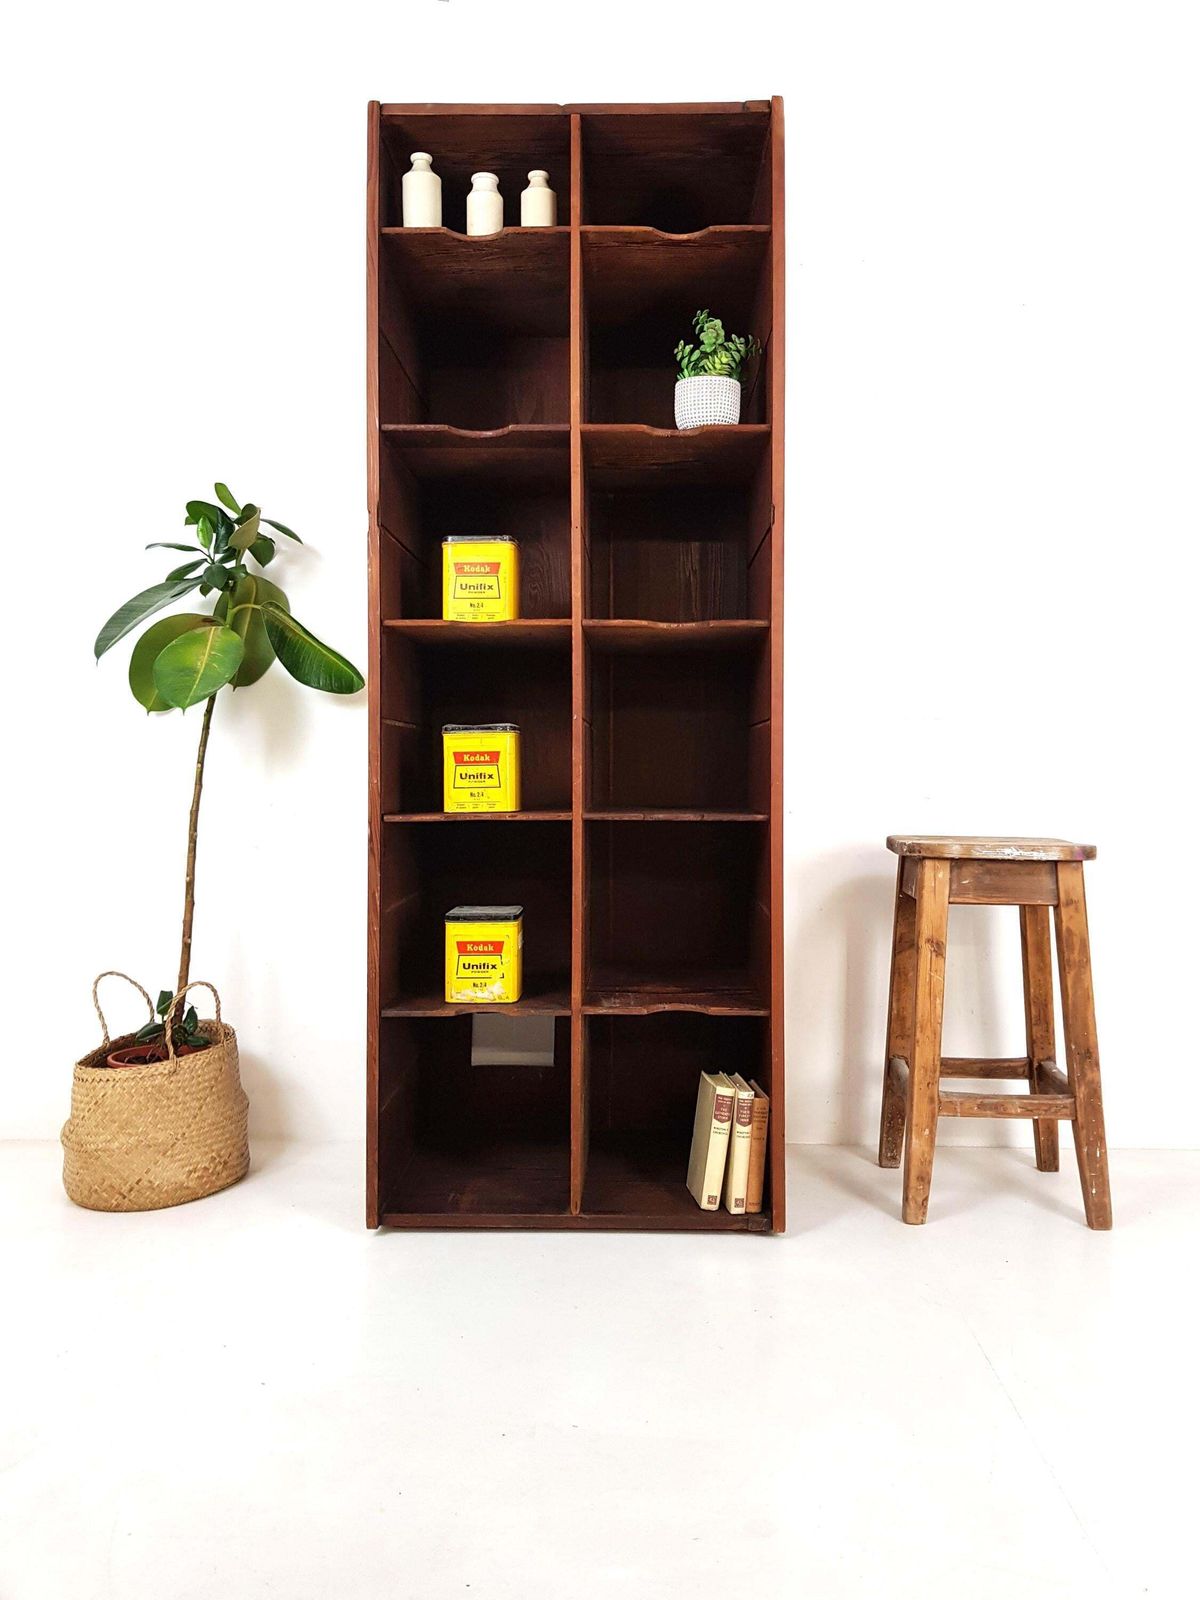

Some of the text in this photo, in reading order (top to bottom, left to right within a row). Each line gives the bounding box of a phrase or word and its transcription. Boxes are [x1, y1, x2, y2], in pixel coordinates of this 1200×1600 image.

[463, 564, 491, 573] Kodak
[460, 583, 494, 591] Unifix
[463, 754, 490, 762] Kodak
[459, 772, 494, 780] Unifix
[466, 943, 494, 952] Kodak
[462, 962, 497, 970] Unifix
